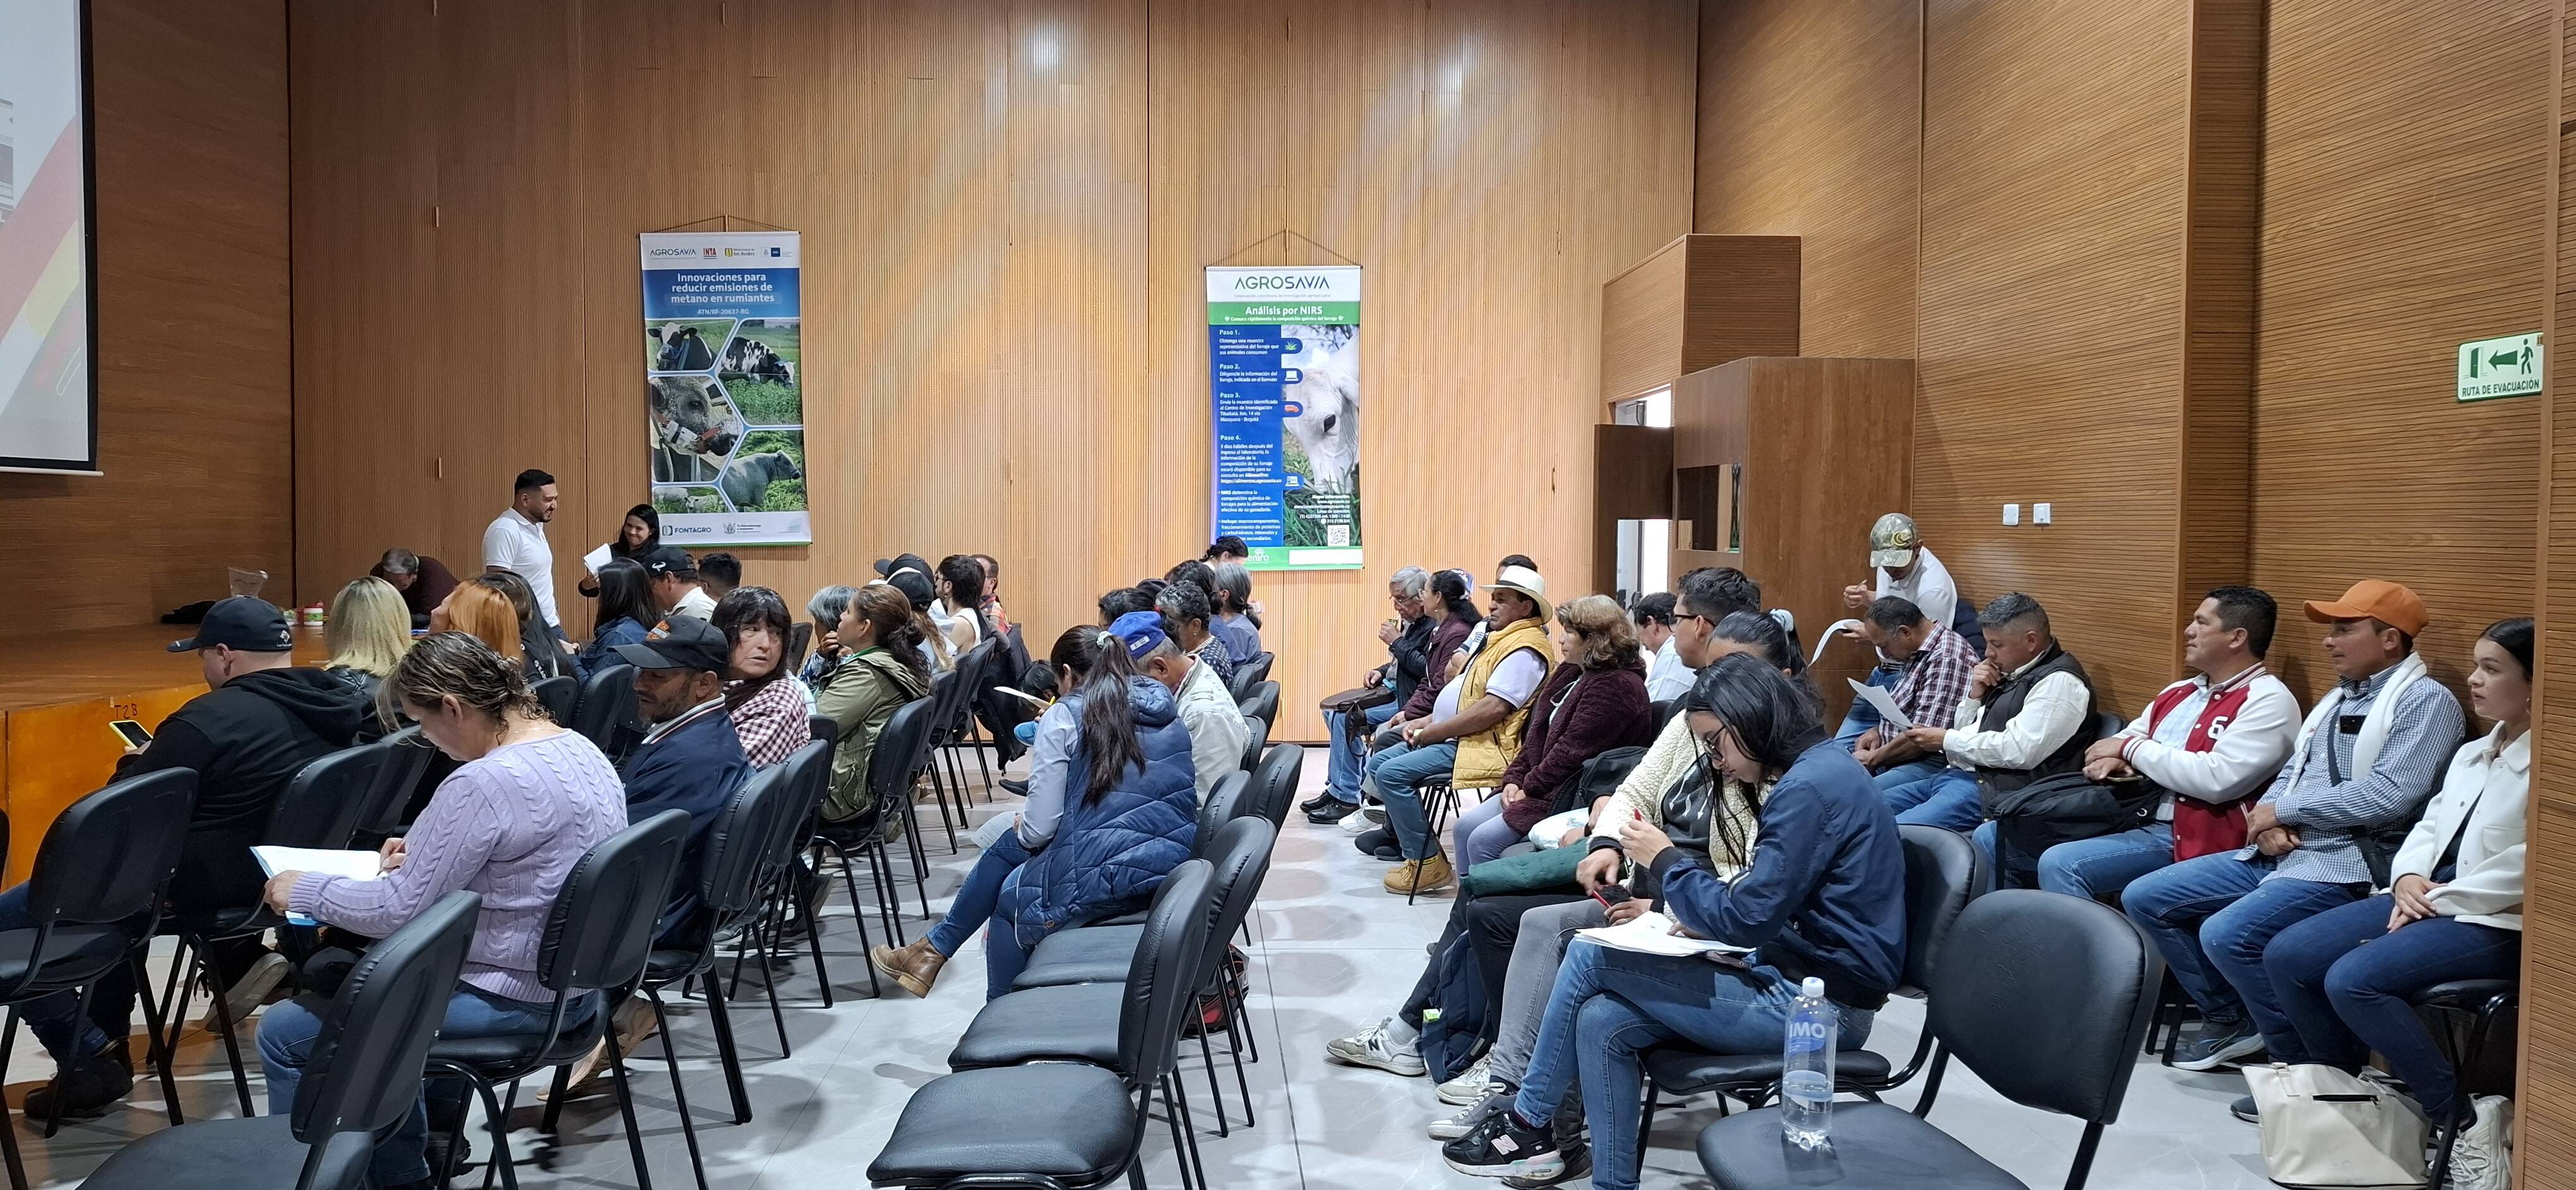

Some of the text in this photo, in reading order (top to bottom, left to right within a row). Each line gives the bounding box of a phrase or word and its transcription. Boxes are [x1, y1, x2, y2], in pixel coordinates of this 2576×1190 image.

[703, 248, 717, 256] INTA
[677, 273, 766, 284] Innovaciones para
[1234, 275, 1330, 289] AGROSAVIA
[672, 282, 773, 292] reducir emisiones de
[671, 294, 708, 304] metano
[725, 292, 775, 303] rumiantes
[1245, 306, 1323, 317] Análisis por NIRS
[2462, 378, 2539, 397] RUTA DE EVACUACIÓN
[114, 702, 138, 719] T2B
[1490, 1134, 1520, 1155] N
